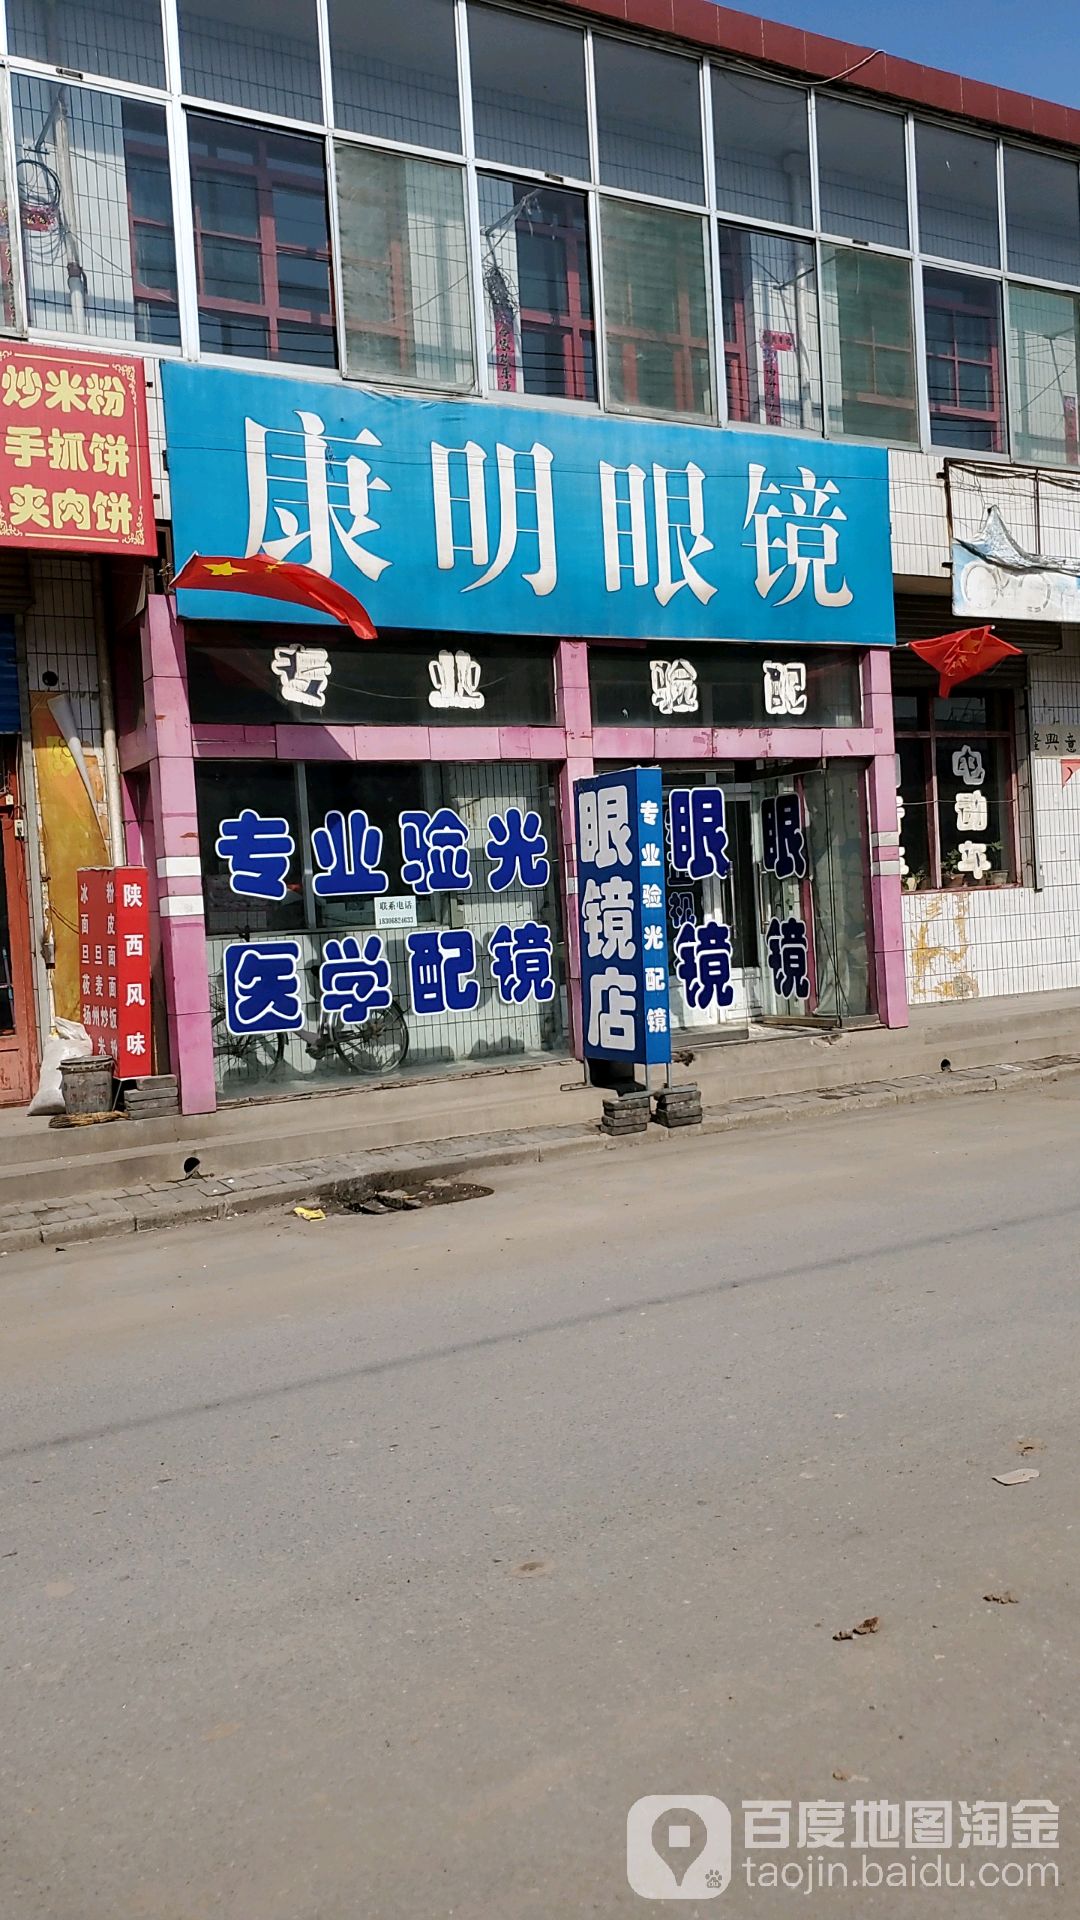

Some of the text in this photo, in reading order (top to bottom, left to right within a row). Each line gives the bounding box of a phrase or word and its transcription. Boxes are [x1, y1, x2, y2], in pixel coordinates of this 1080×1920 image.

[2, 365, 126, 417] 炒米粉
[5, 426, 130, 478] 手抓饼
[9, 483, 133, 535] 夹肉饼
[244, 409, 854, 608] 康明眼镜
[215, 806, 550, 900] 专业验光
[380, 901, 412, 910] 联系电话
[578, 785, 636, 1051] 眼镜店
[640, 800, 667, 1034] 专业验光配镜
[669, 787, 734, 1010] 眼镜
[761, 792, 810, 1000] 眼镜
[123, 884, 146, 1056] 陕西风味
[223, 920, 555, 1035] 医学配镜
